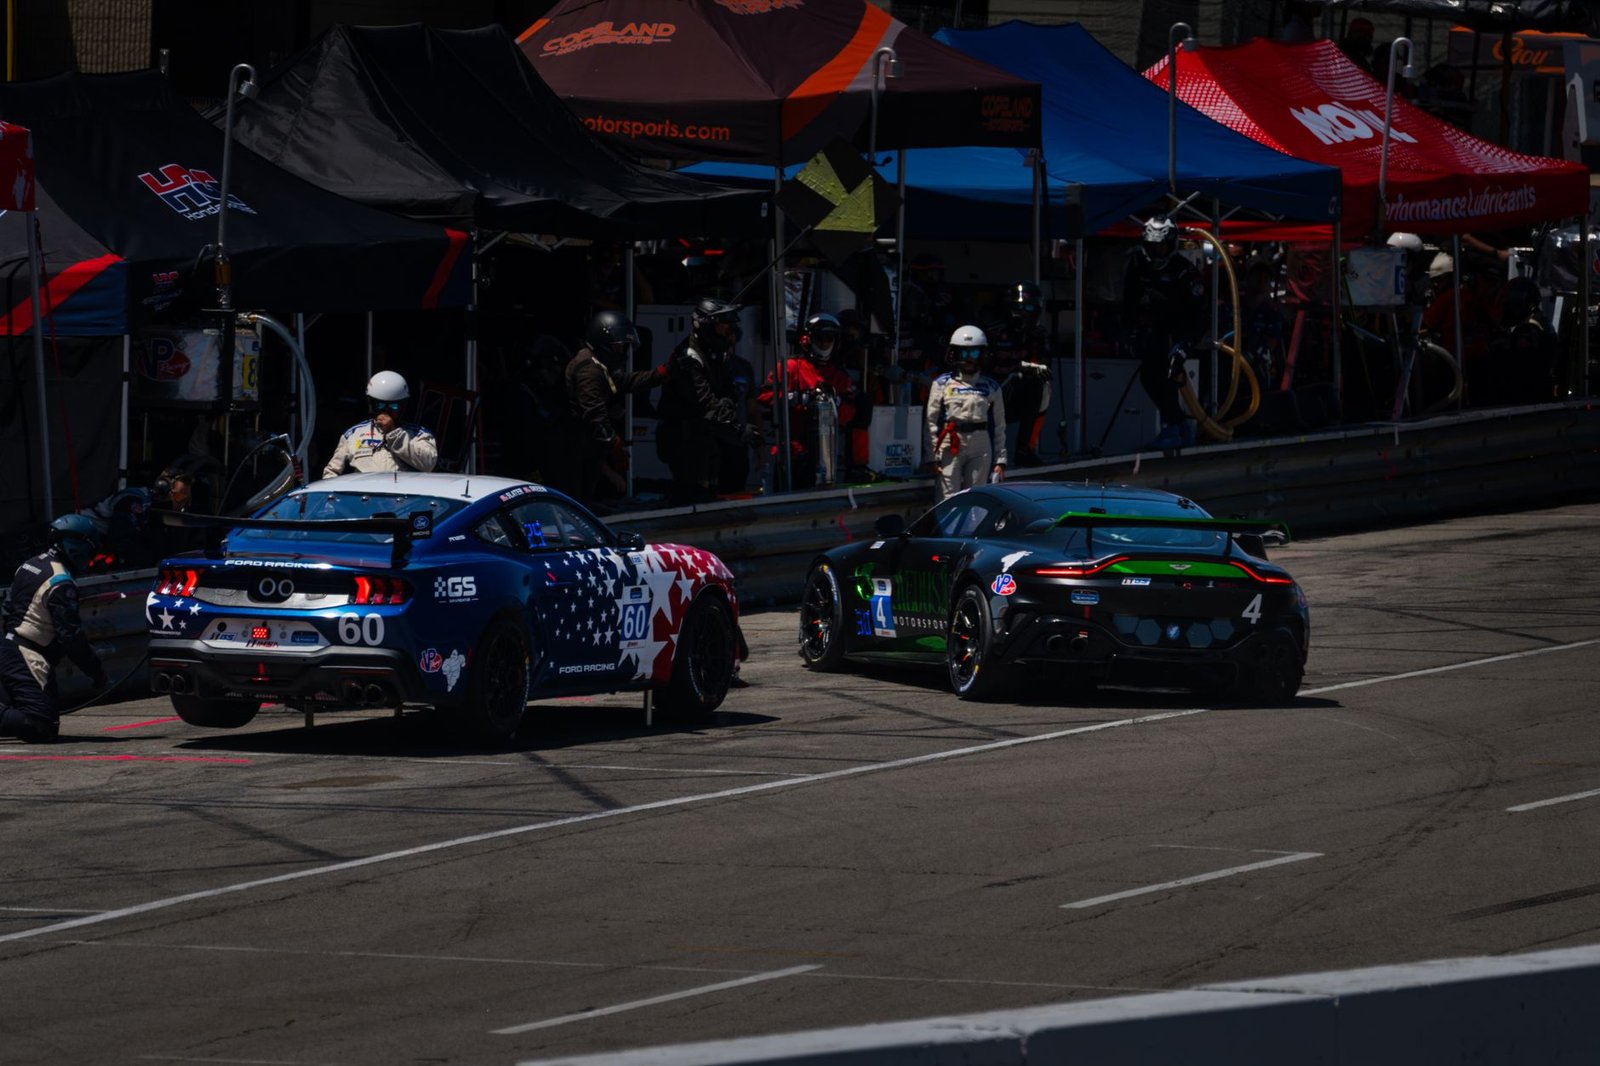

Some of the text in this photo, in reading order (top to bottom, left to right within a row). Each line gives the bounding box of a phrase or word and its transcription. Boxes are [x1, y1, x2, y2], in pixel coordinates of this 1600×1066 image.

[580, 114, 732, 141] otorsports.com
[1468, 183, 1537, 217] Lubricants
[224, 559, 261, 567] FORD
[447, 575, 477, 598] GS
[623, 604, 647, 640] 60
[876, 597, 887, 629] 4
[1241, 593, 1263, 625] 4
[338, 611, 385, 647] 60
[559, 662, 616, 675] FORD RACING
